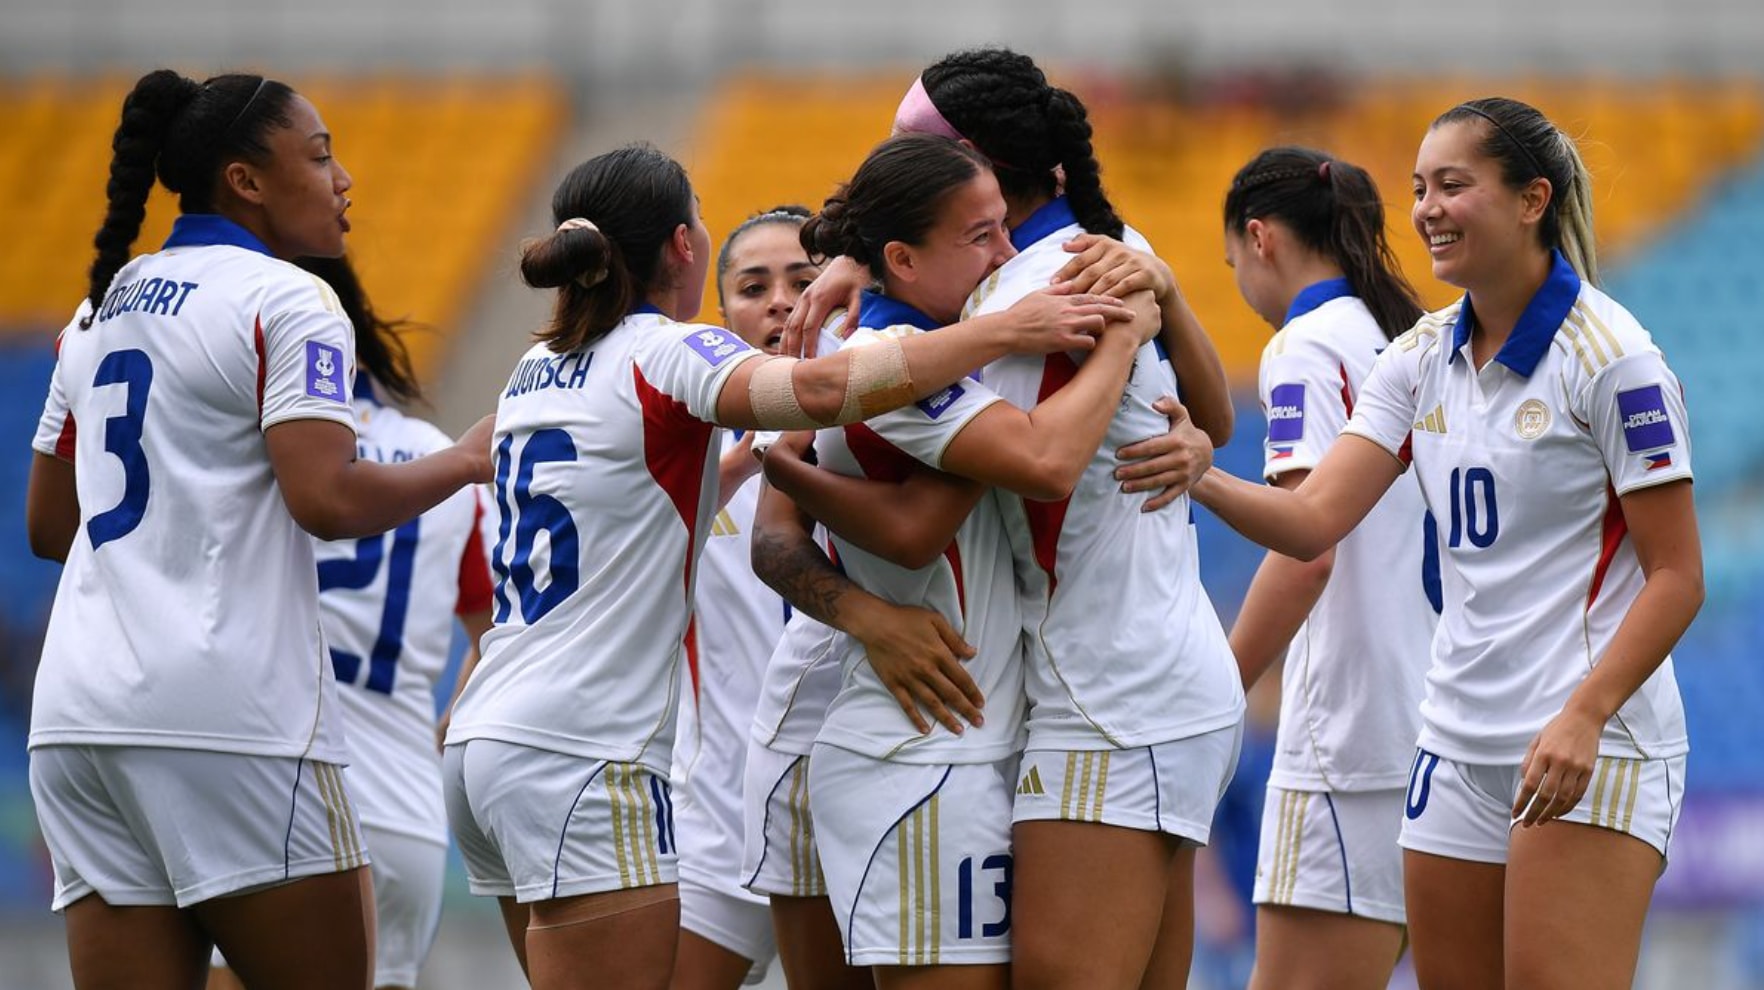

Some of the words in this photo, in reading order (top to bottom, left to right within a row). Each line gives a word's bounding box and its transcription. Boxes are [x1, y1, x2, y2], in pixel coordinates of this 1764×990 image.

[87, 348, 153, 552] 3
[1449, 466, 1498, 548] 10
[493, 428, 579, 626] 16
[958, 854, 1014, 939] 13
